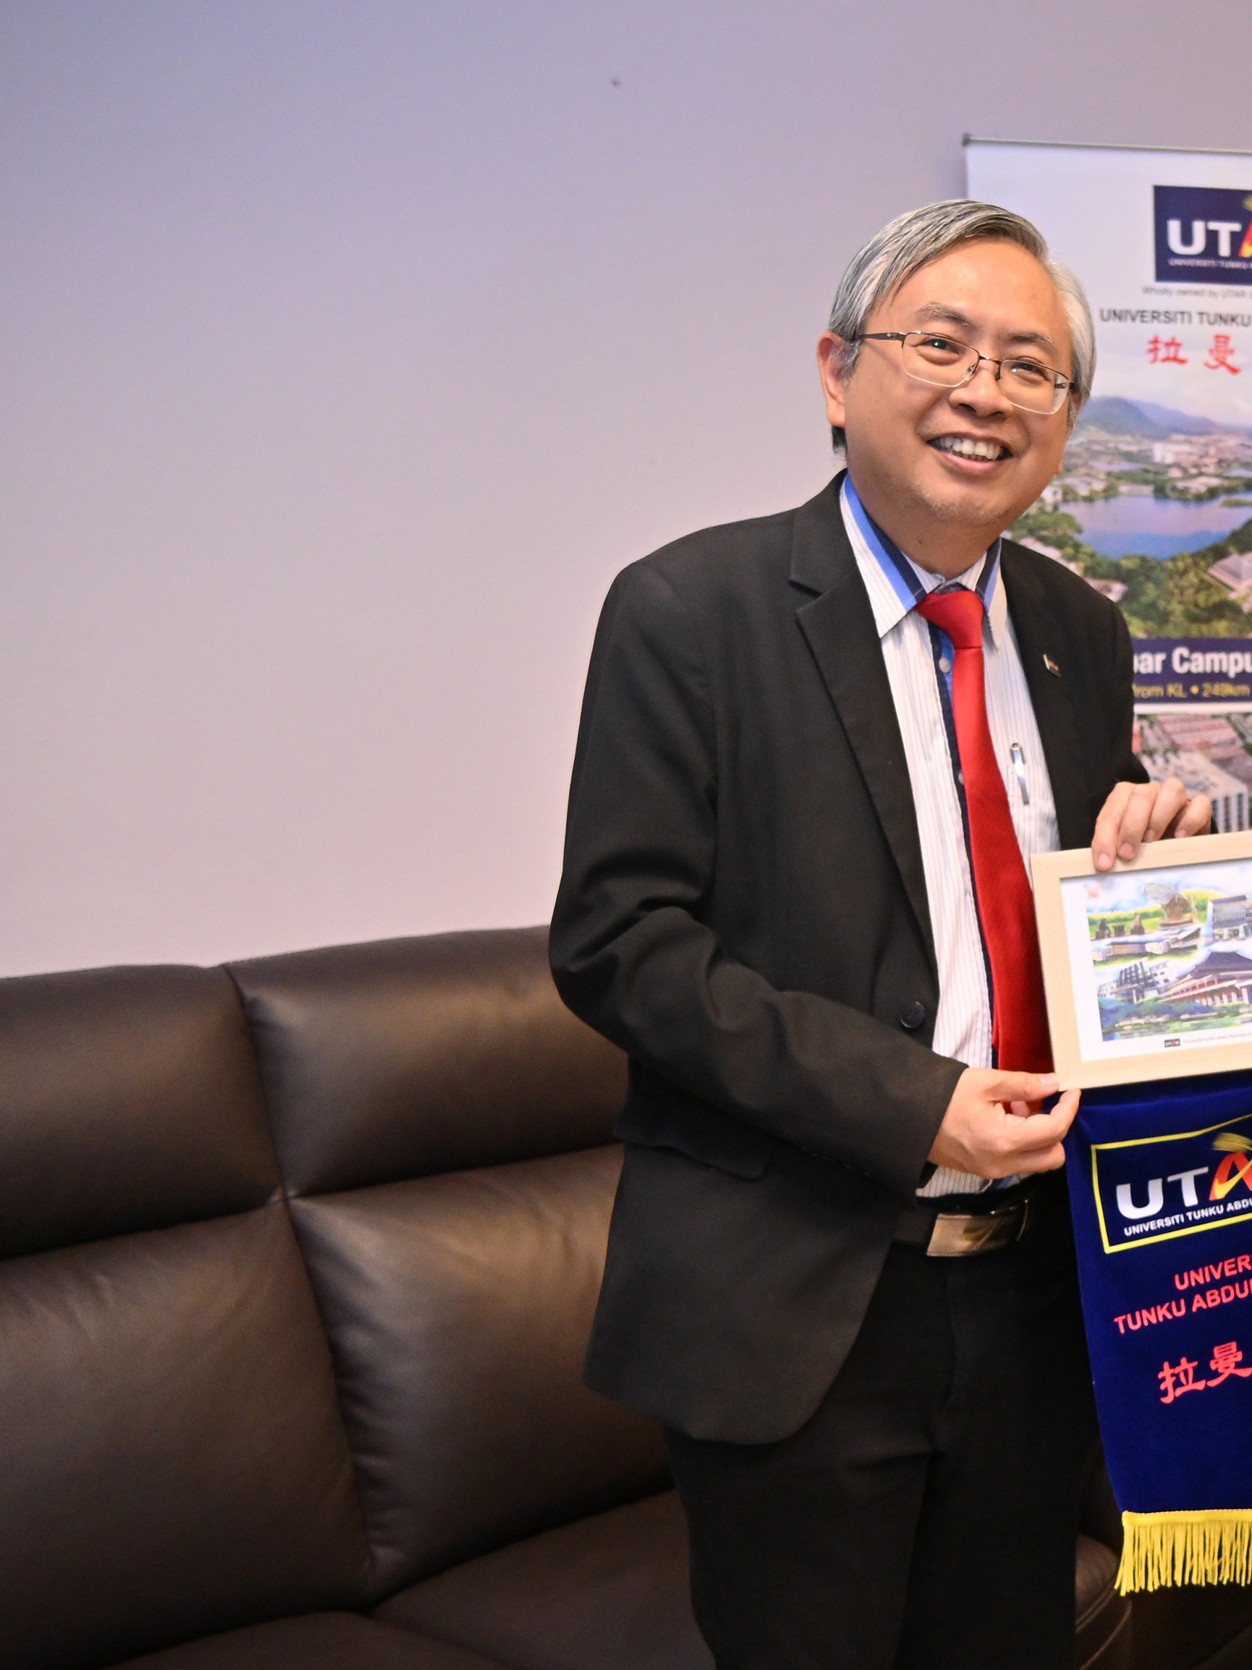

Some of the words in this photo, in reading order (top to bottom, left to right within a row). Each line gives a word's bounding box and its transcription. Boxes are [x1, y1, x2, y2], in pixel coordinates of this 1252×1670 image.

[1100, 309, 1192, 325] UNIVERSITI
[1197, 311, 1252, 328] TUNKU
[1167, 683, 1188, 698] KL
[1124, 1214, 1184, 1237] UNIVERSITI
[1188, 1204, 1225, 1221] TUNKU
[1113, 1299, 1186, 1334] TUNKU
